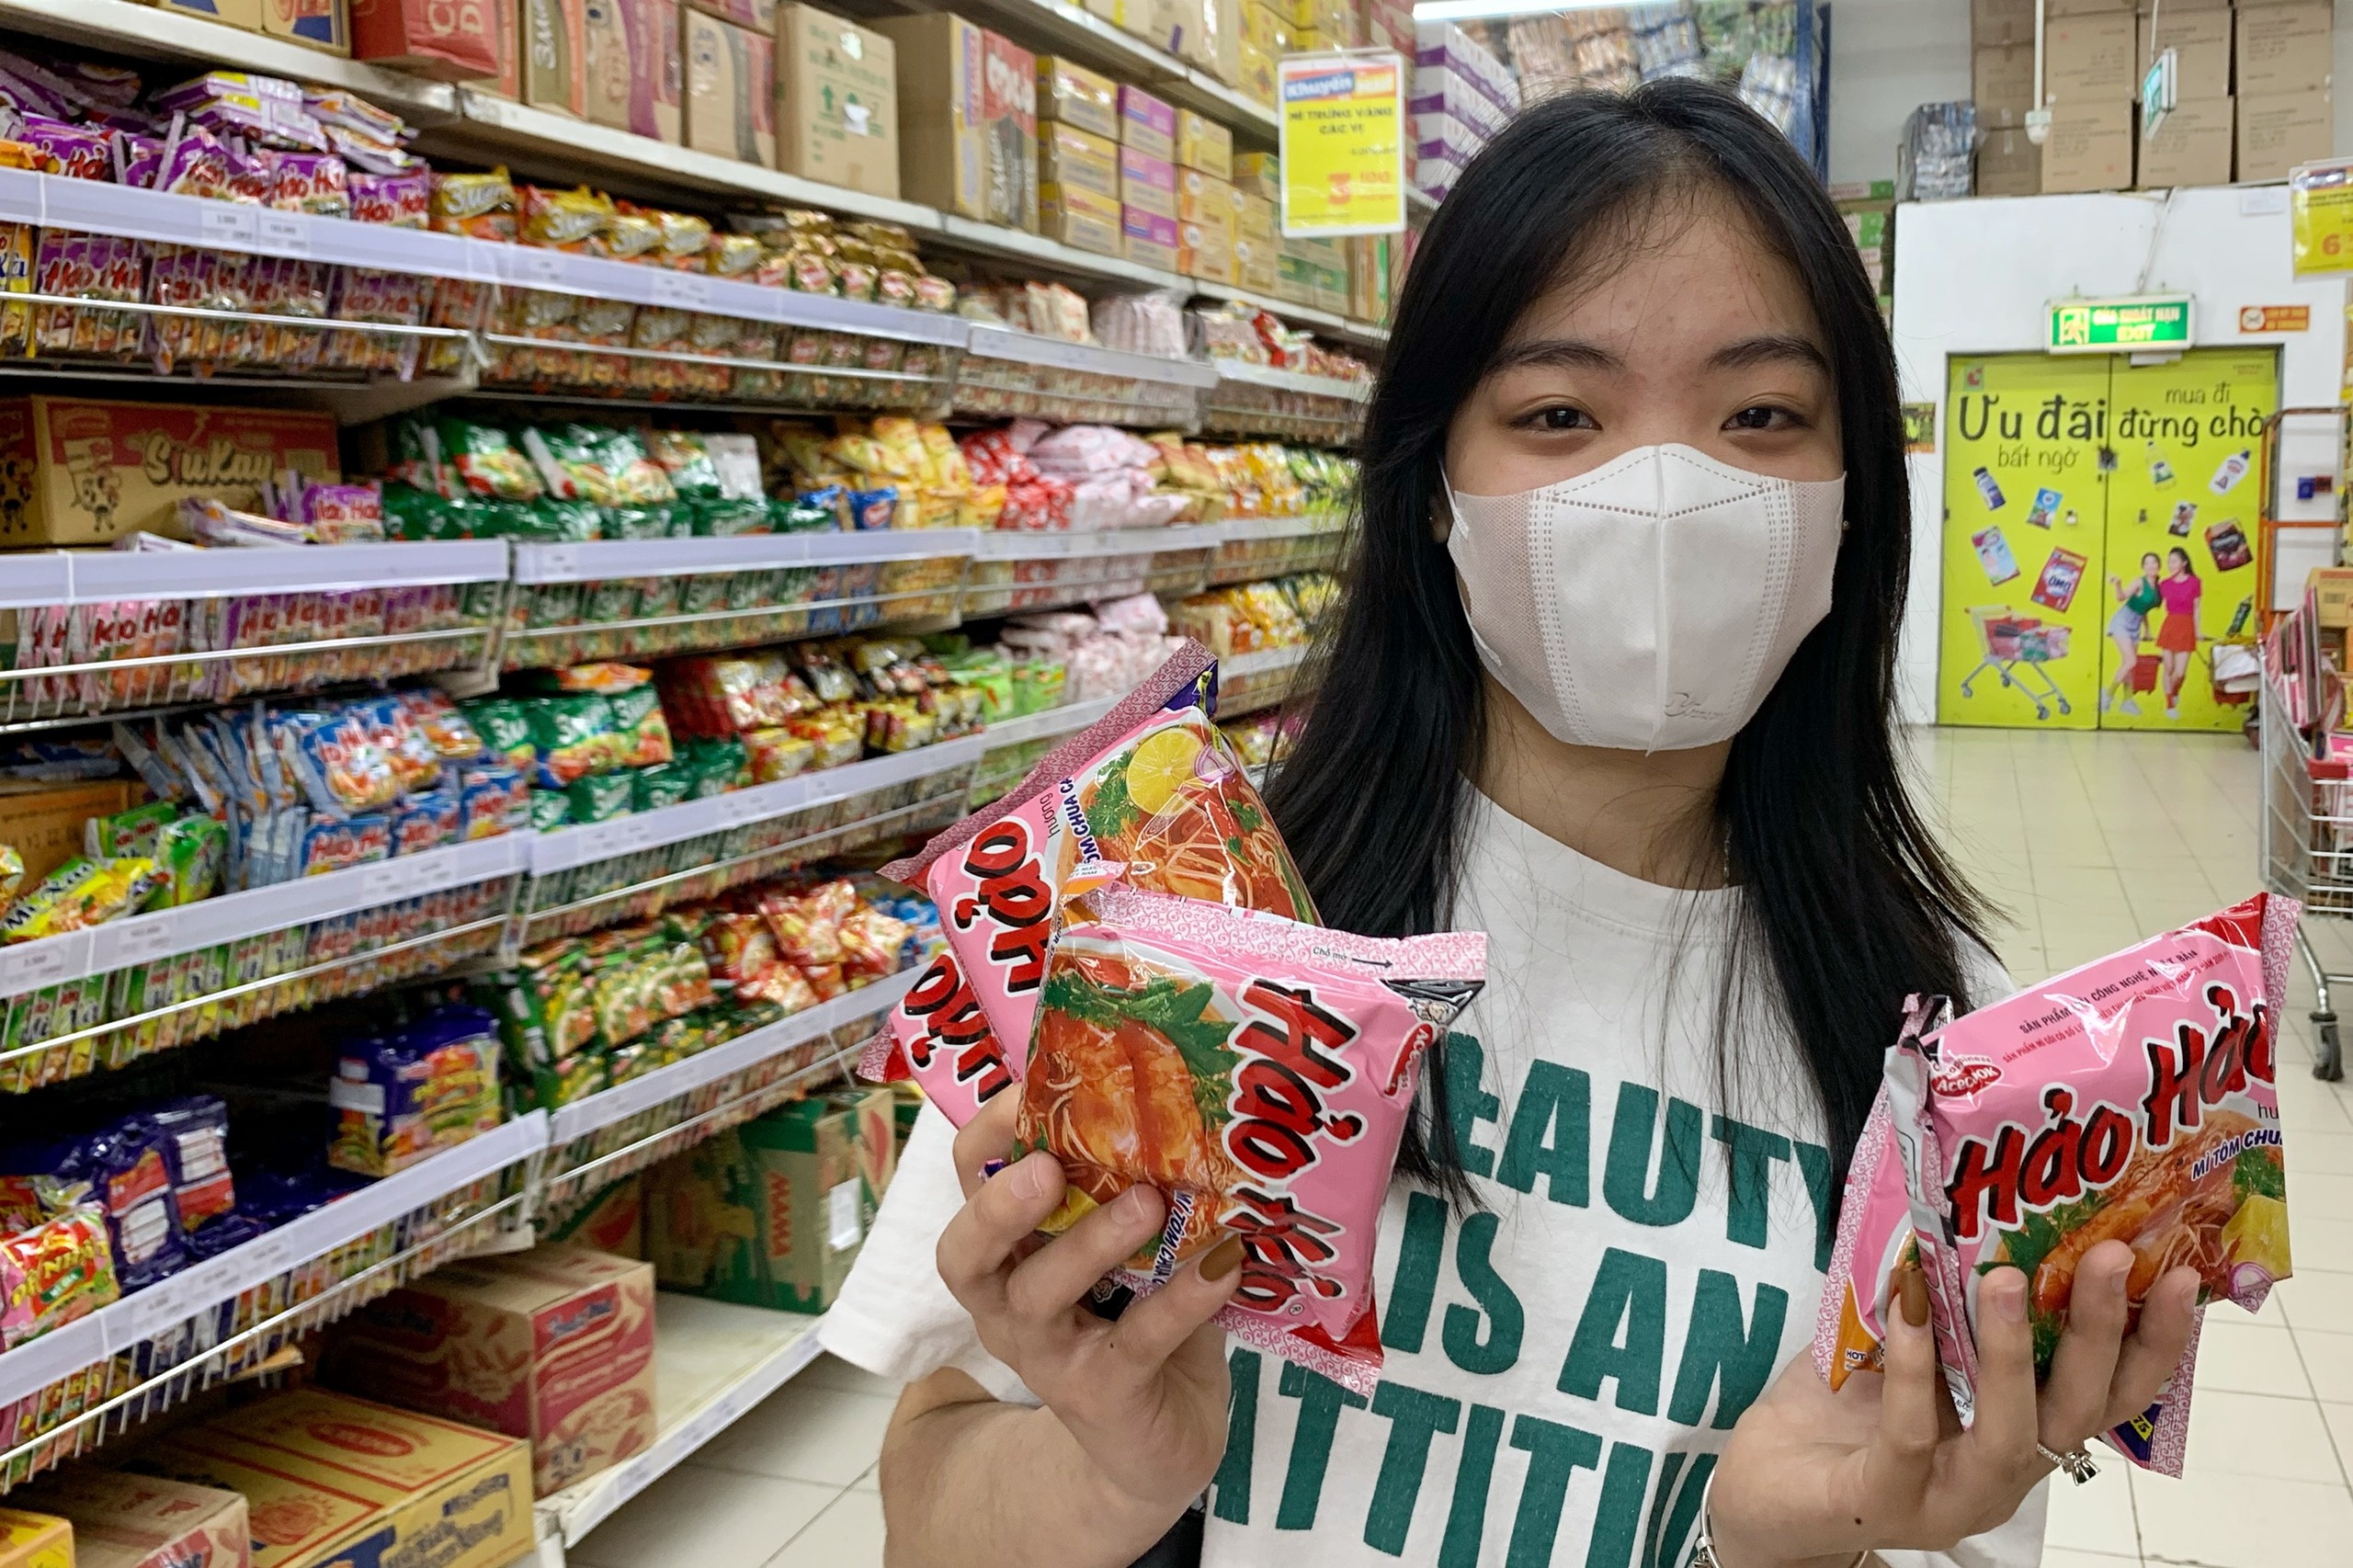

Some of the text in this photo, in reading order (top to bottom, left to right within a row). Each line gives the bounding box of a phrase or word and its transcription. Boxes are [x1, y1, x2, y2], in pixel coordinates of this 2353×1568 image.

[2322, 233, 2341, 256] 6
[2165, 381, 2231, 404] mua đi
[1959, 393, 2106, 442] Ưu đãi
[2119, 406, 2200, 447] đừng
[1997, 444, 2081, 474] bất ngờ
[1063, 794, 1090, 835] CHUA
[2090, 983, 2120, 1002] CÔNG
[1228, 978, 1362, 1181] Hảo
[1944, 1087, 2134, 1238] Hảo
[2192, 1129, 2282, 1180] MÌ TÔM CHU
[1381, 1191, 1790, 1431] IS AN
[1846, 1349, 1866, 1362] HOT
